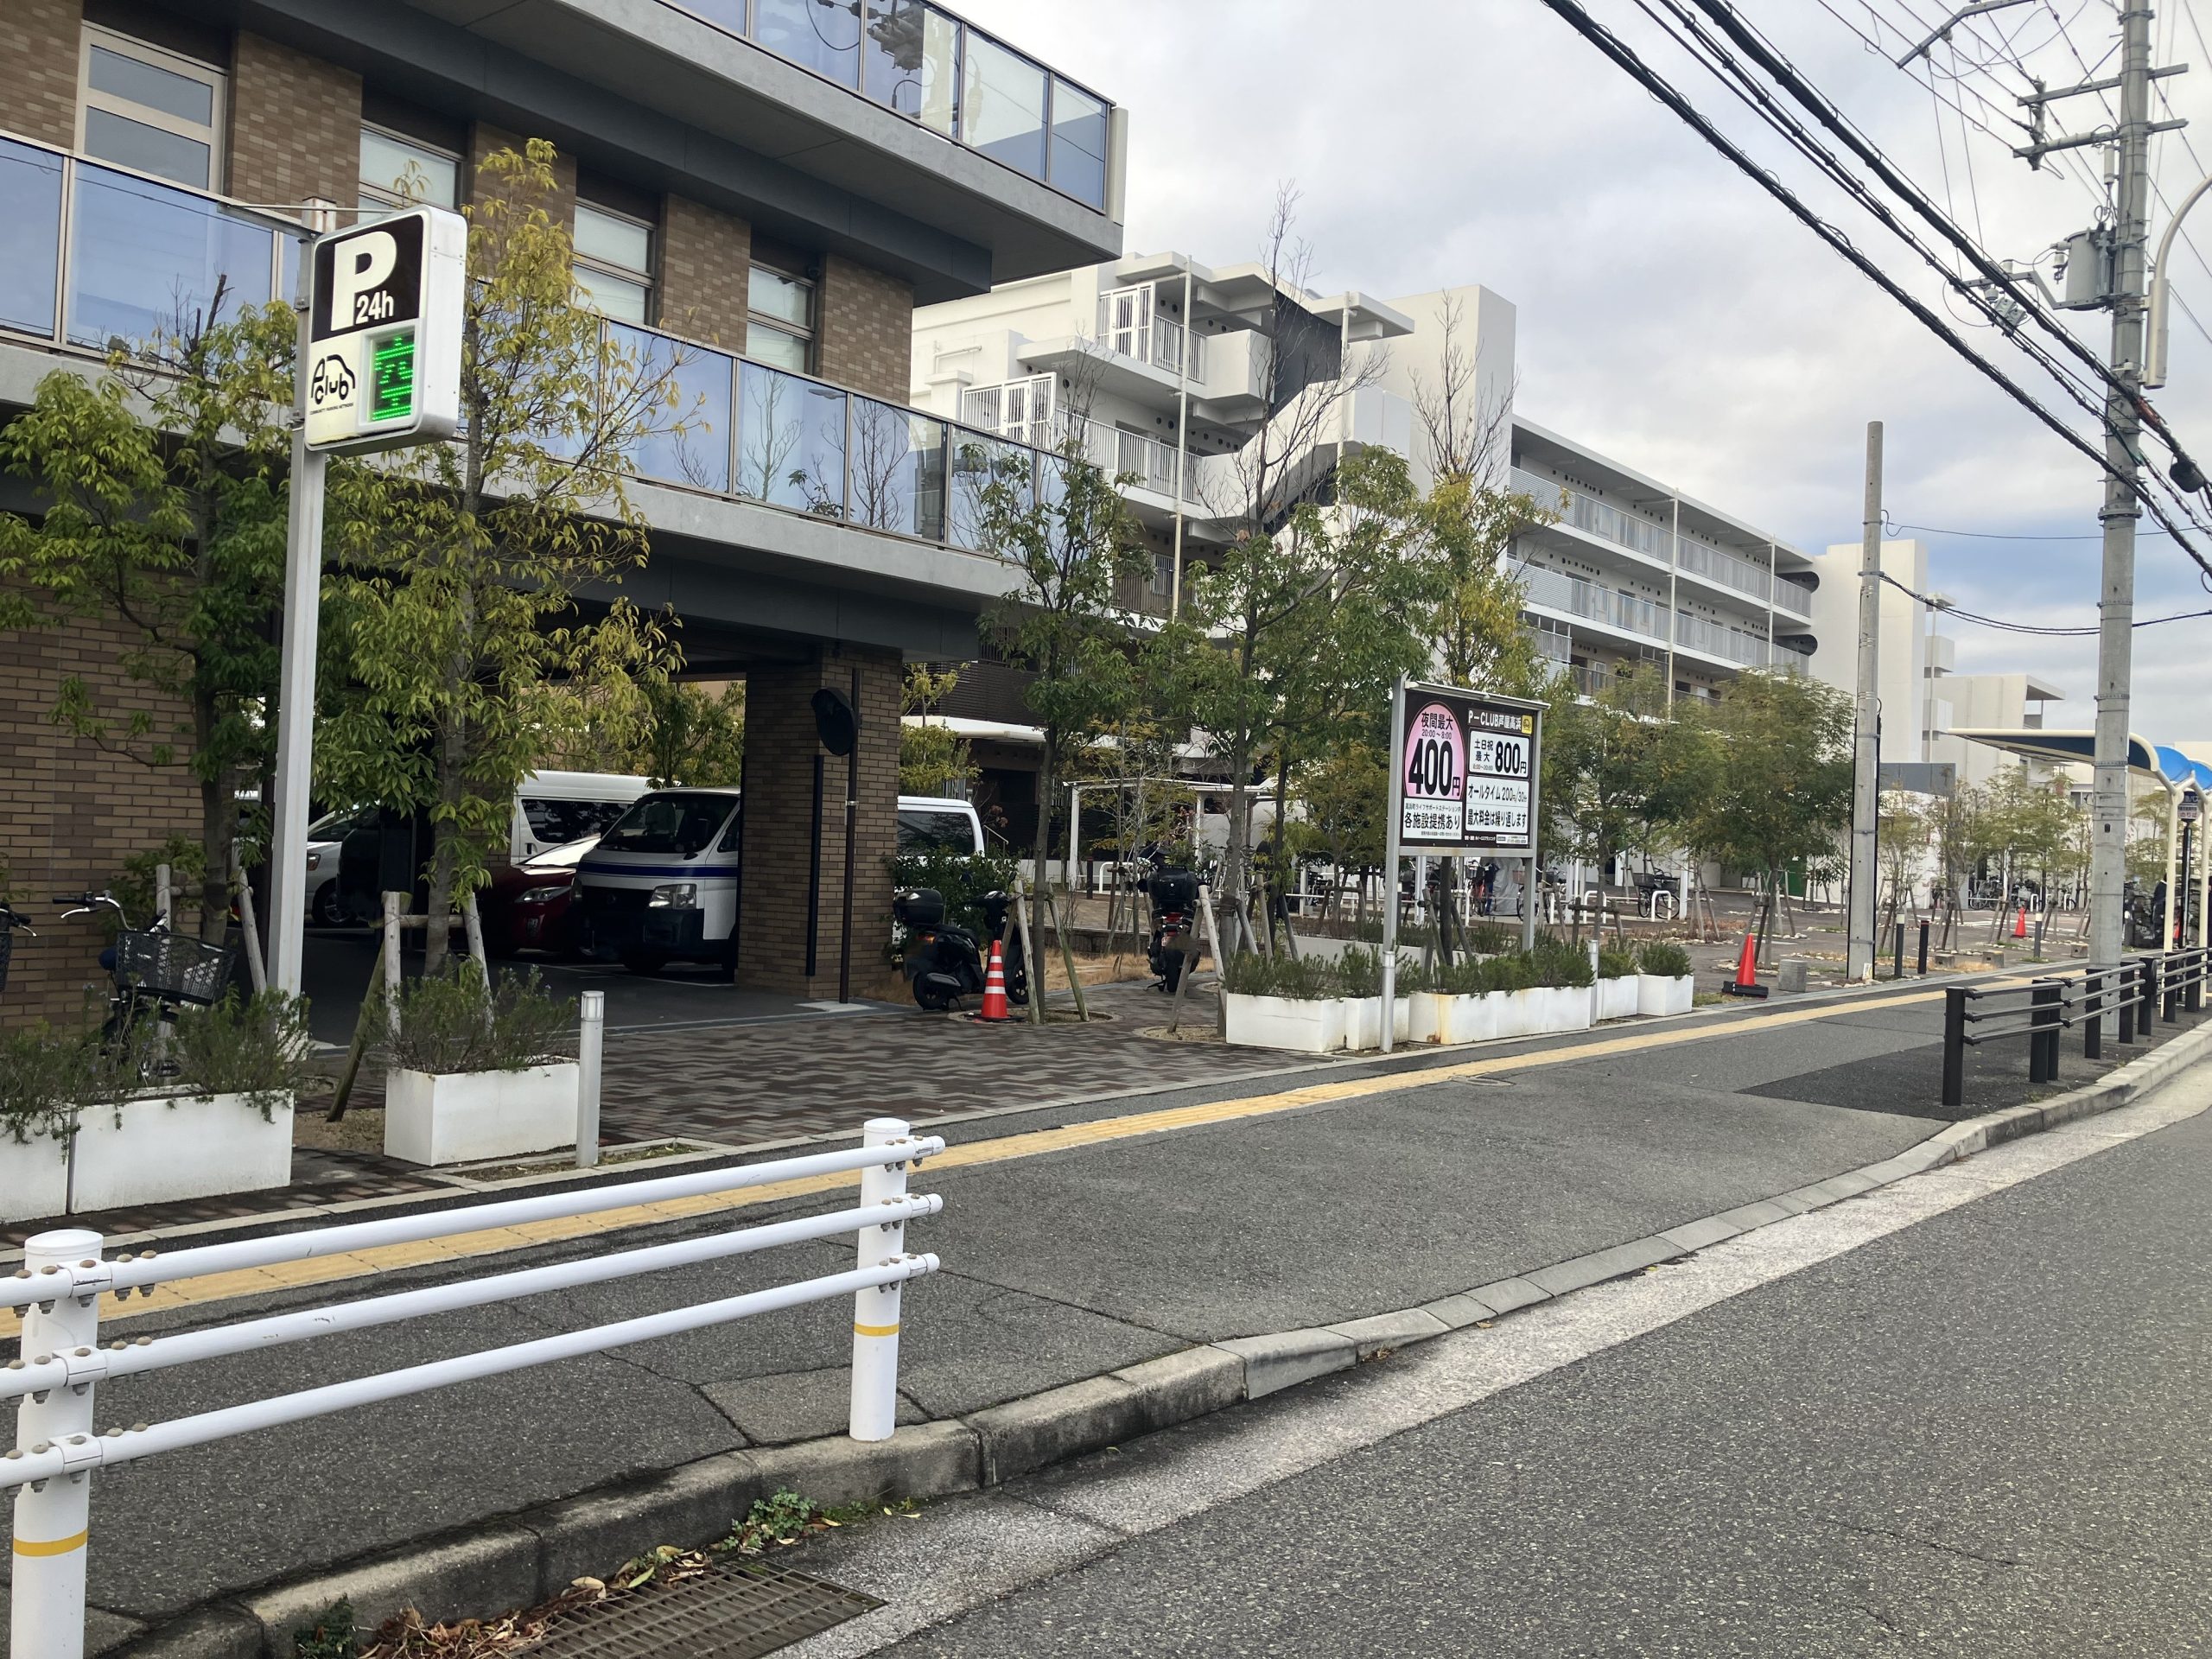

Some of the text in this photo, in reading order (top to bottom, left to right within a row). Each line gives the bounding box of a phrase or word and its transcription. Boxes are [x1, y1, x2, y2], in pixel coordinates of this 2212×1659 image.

[331, 231, 397, 332] P
[355, 289, 394, 325] 24h
[372, 337, 415, 421] 空
[1421, 712, 1453, 731] 夜間最大
[1474, 739, 1493, 751] 土日祝
[1495, 741, 1527, 775] 800円
[1408, 738, 1460, 797] 400円
[1404, 811, 1460, 830] 各施設提携あり
[1467, 809, 1527, 828] 最大料金は繰り返します
